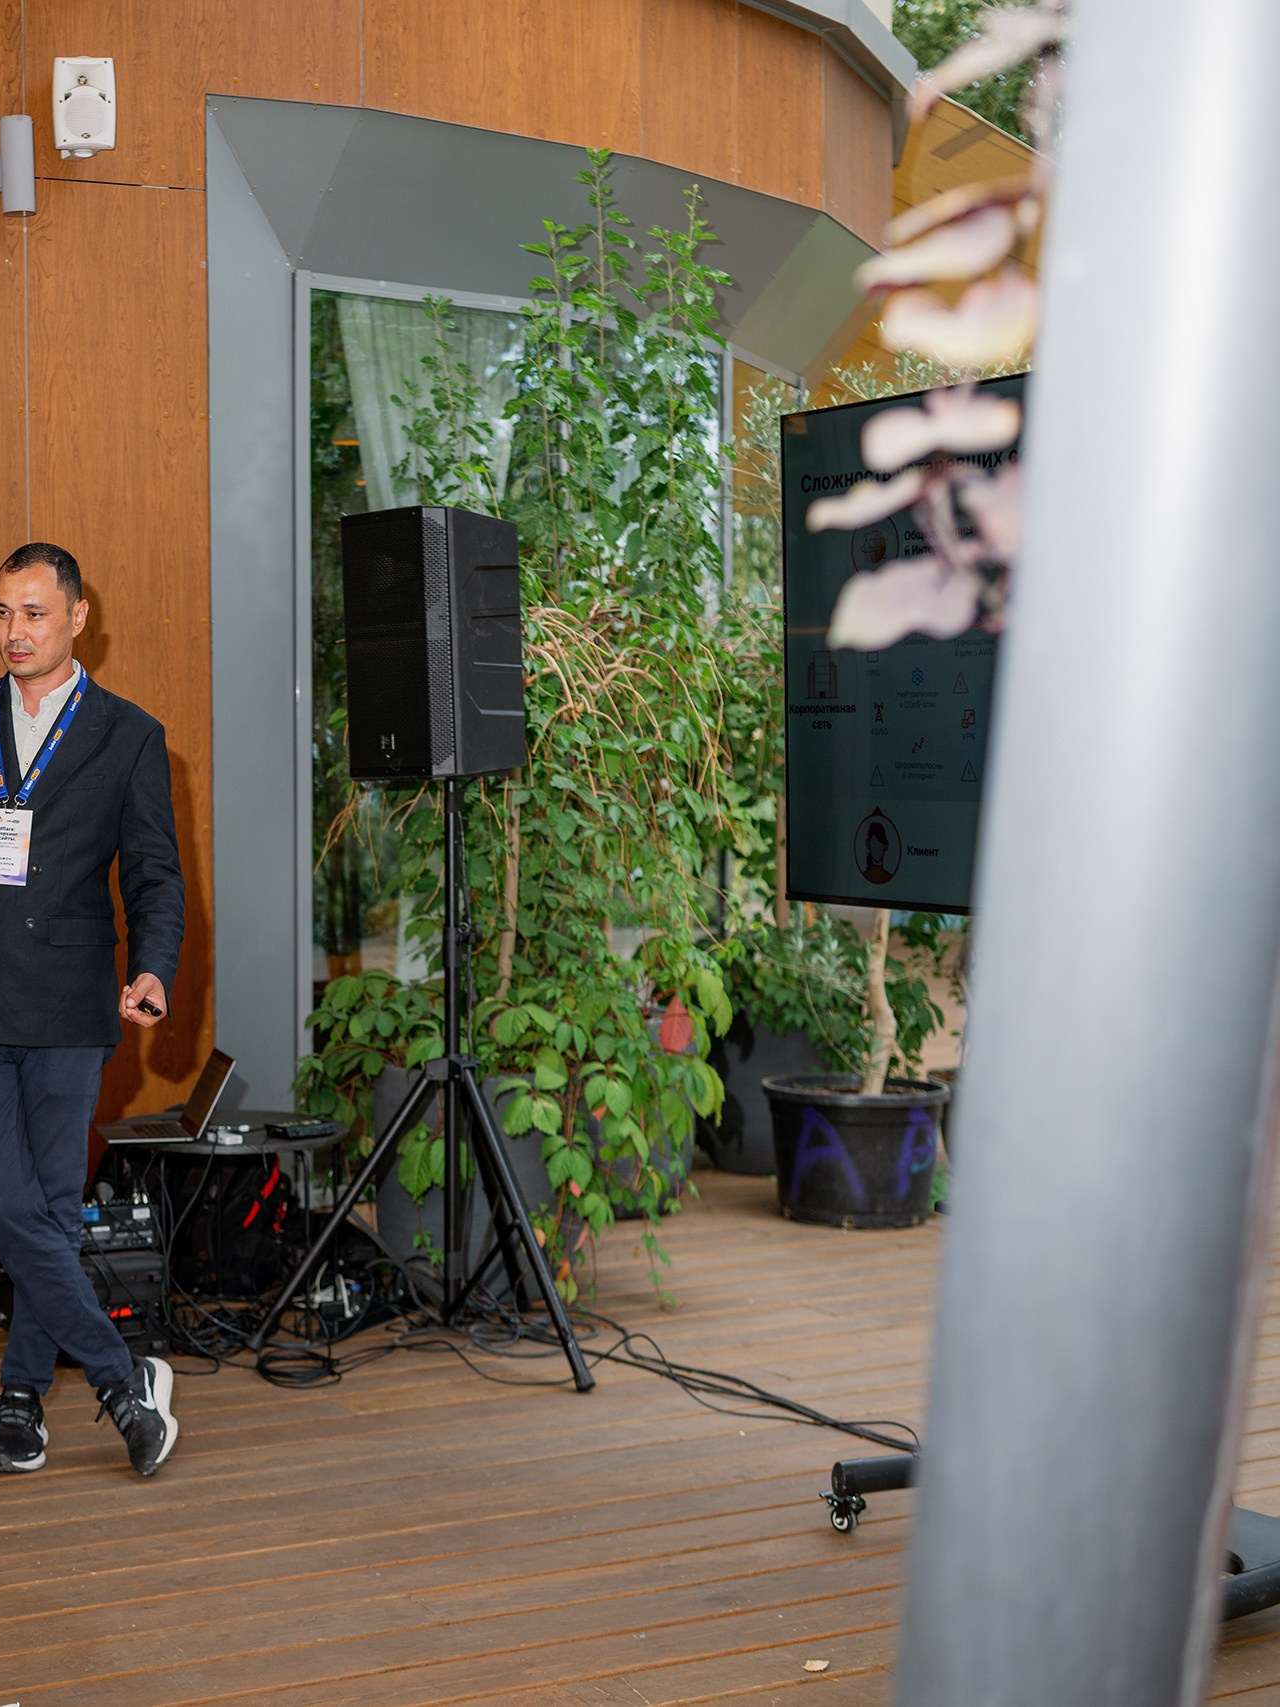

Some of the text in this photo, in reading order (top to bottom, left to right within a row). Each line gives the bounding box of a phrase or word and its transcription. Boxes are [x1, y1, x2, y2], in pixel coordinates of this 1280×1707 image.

[789, 704, 856, 717] Корпоративная
[812, 721, 832, 730] сеть
[962, 732, 976, 741] VPN
[906, 845, 940, 857] Клиент
